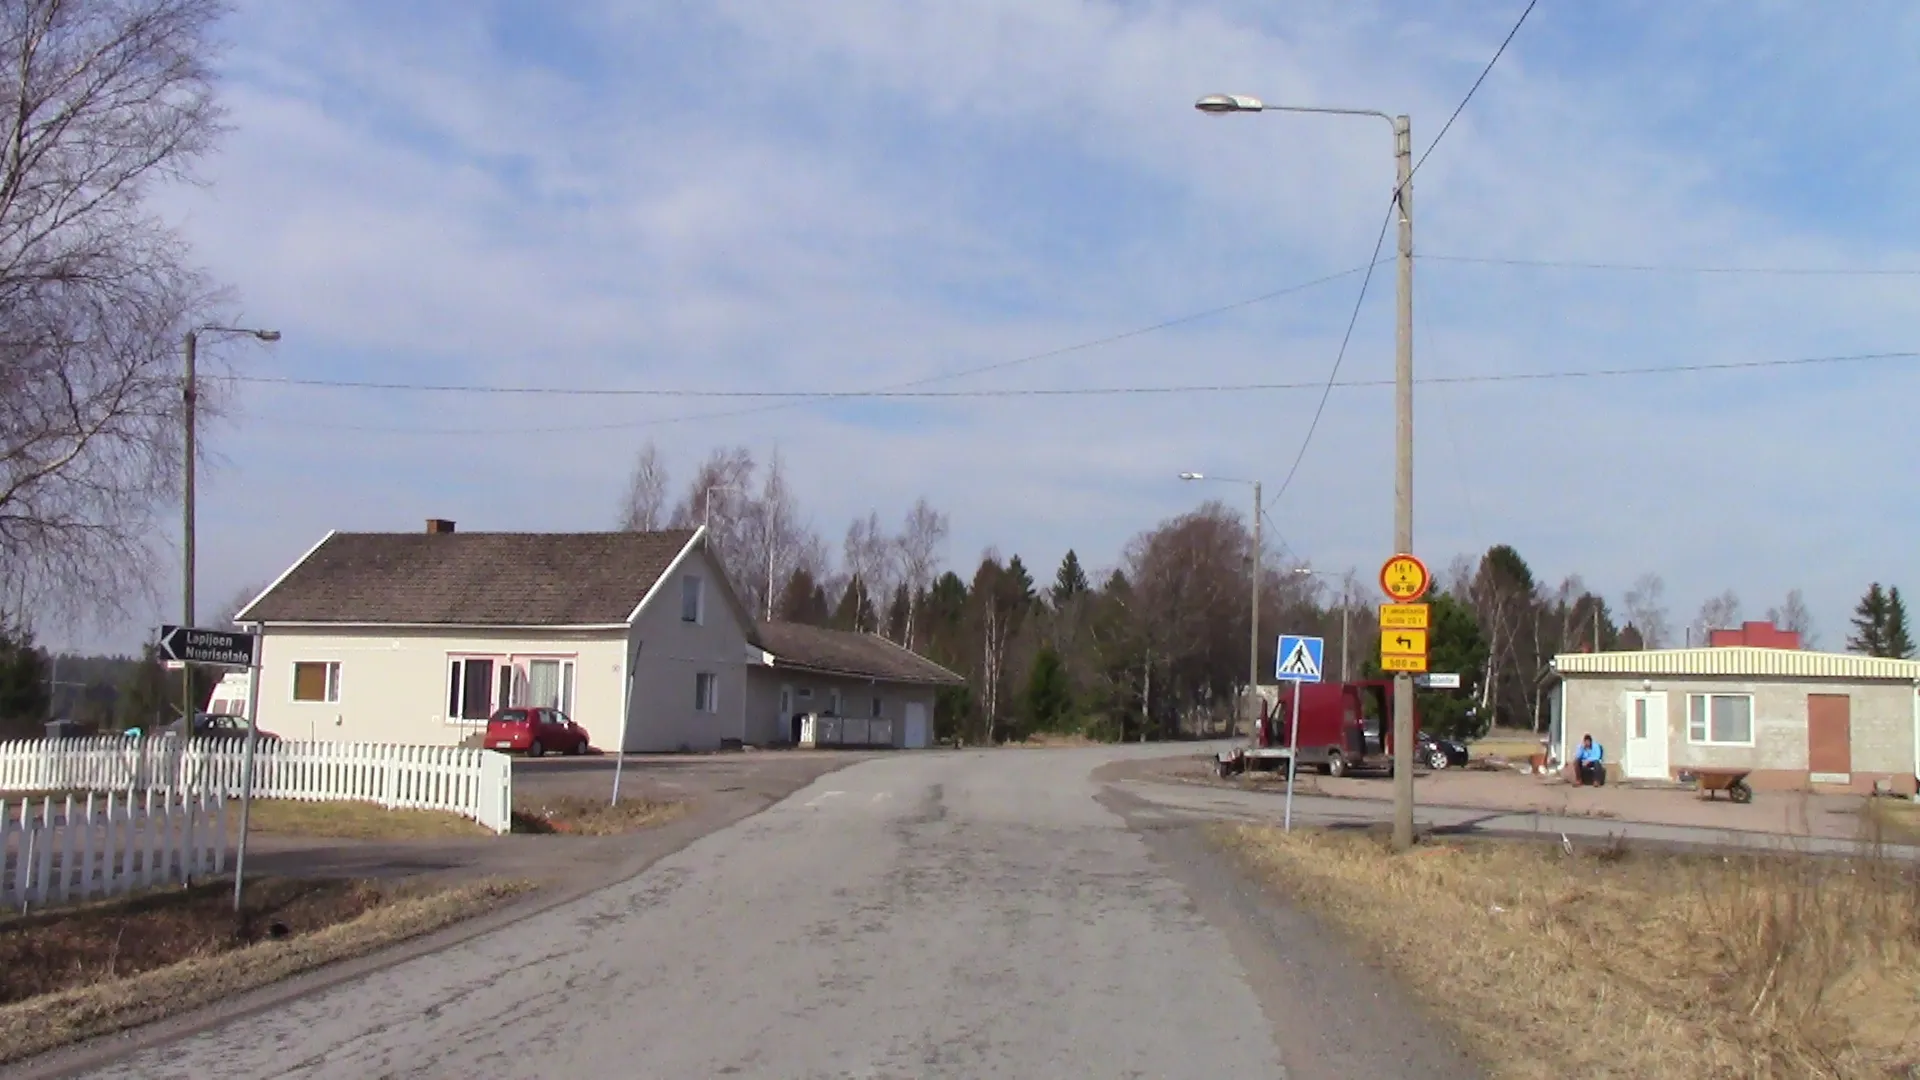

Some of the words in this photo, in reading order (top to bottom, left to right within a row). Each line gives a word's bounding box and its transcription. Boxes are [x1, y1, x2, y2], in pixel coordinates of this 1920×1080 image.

[1395, 563, 1405, 573] 16
[186, 631, 233, 646] Lapijoen
[185, 646, 249, 662] Nuorisotalo
[1389, 659, 1407, 668] 500
